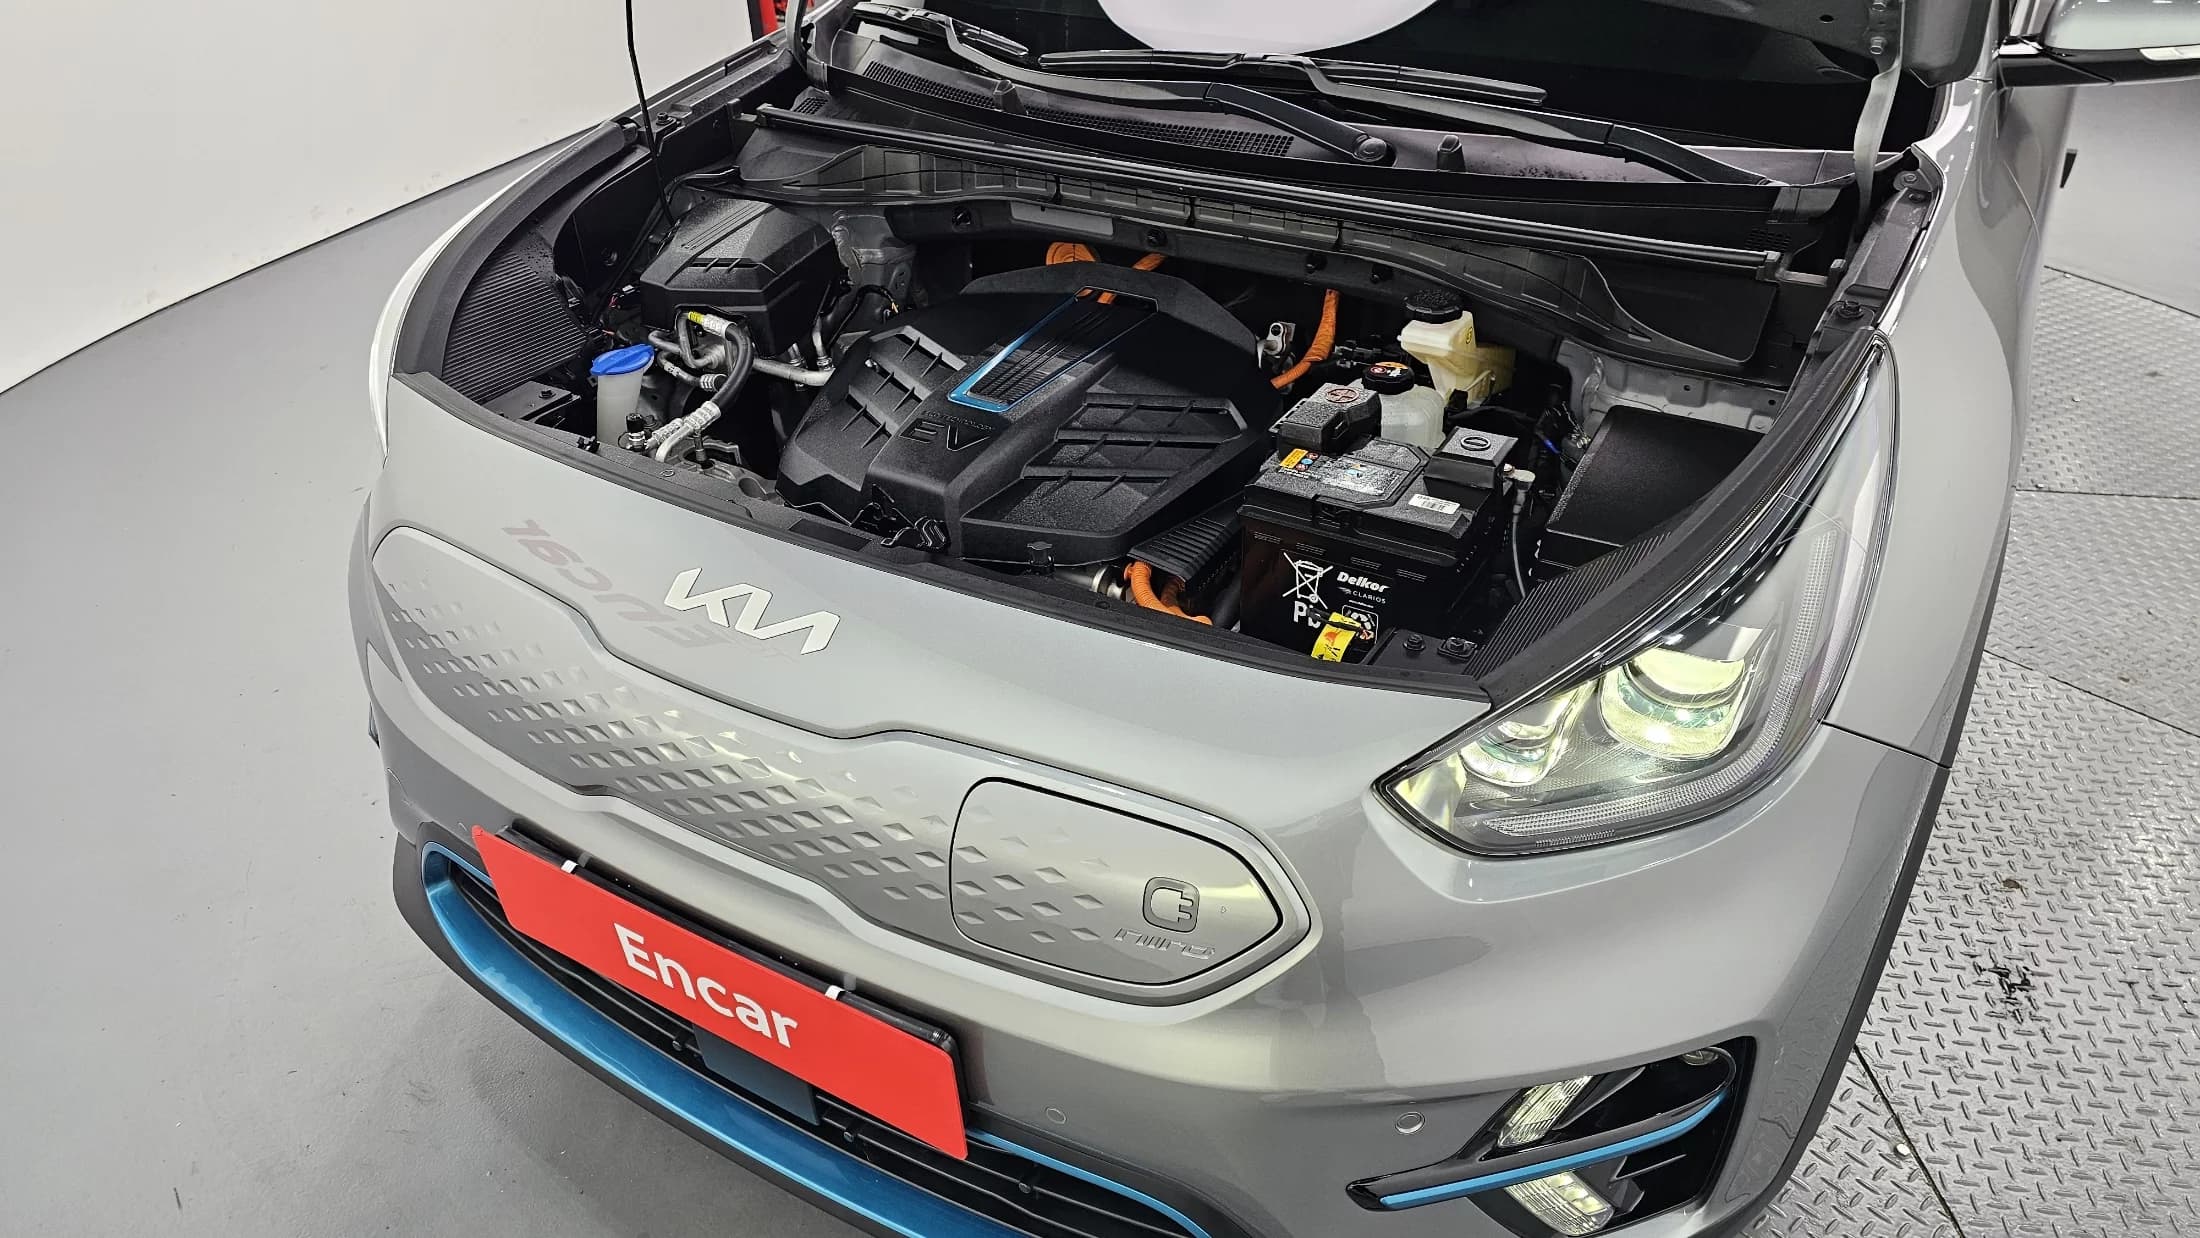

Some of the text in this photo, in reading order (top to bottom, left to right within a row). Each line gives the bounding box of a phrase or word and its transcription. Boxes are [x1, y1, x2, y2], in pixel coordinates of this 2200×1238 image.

[899, 418, 992, 451] EV
[1337, 572, 1391, 593] Delkor
[1353, 590, 1385, 604] CLARIOS
[664, 568, 840, 655] KIA
[614, 923, 798, 1048] Encar
